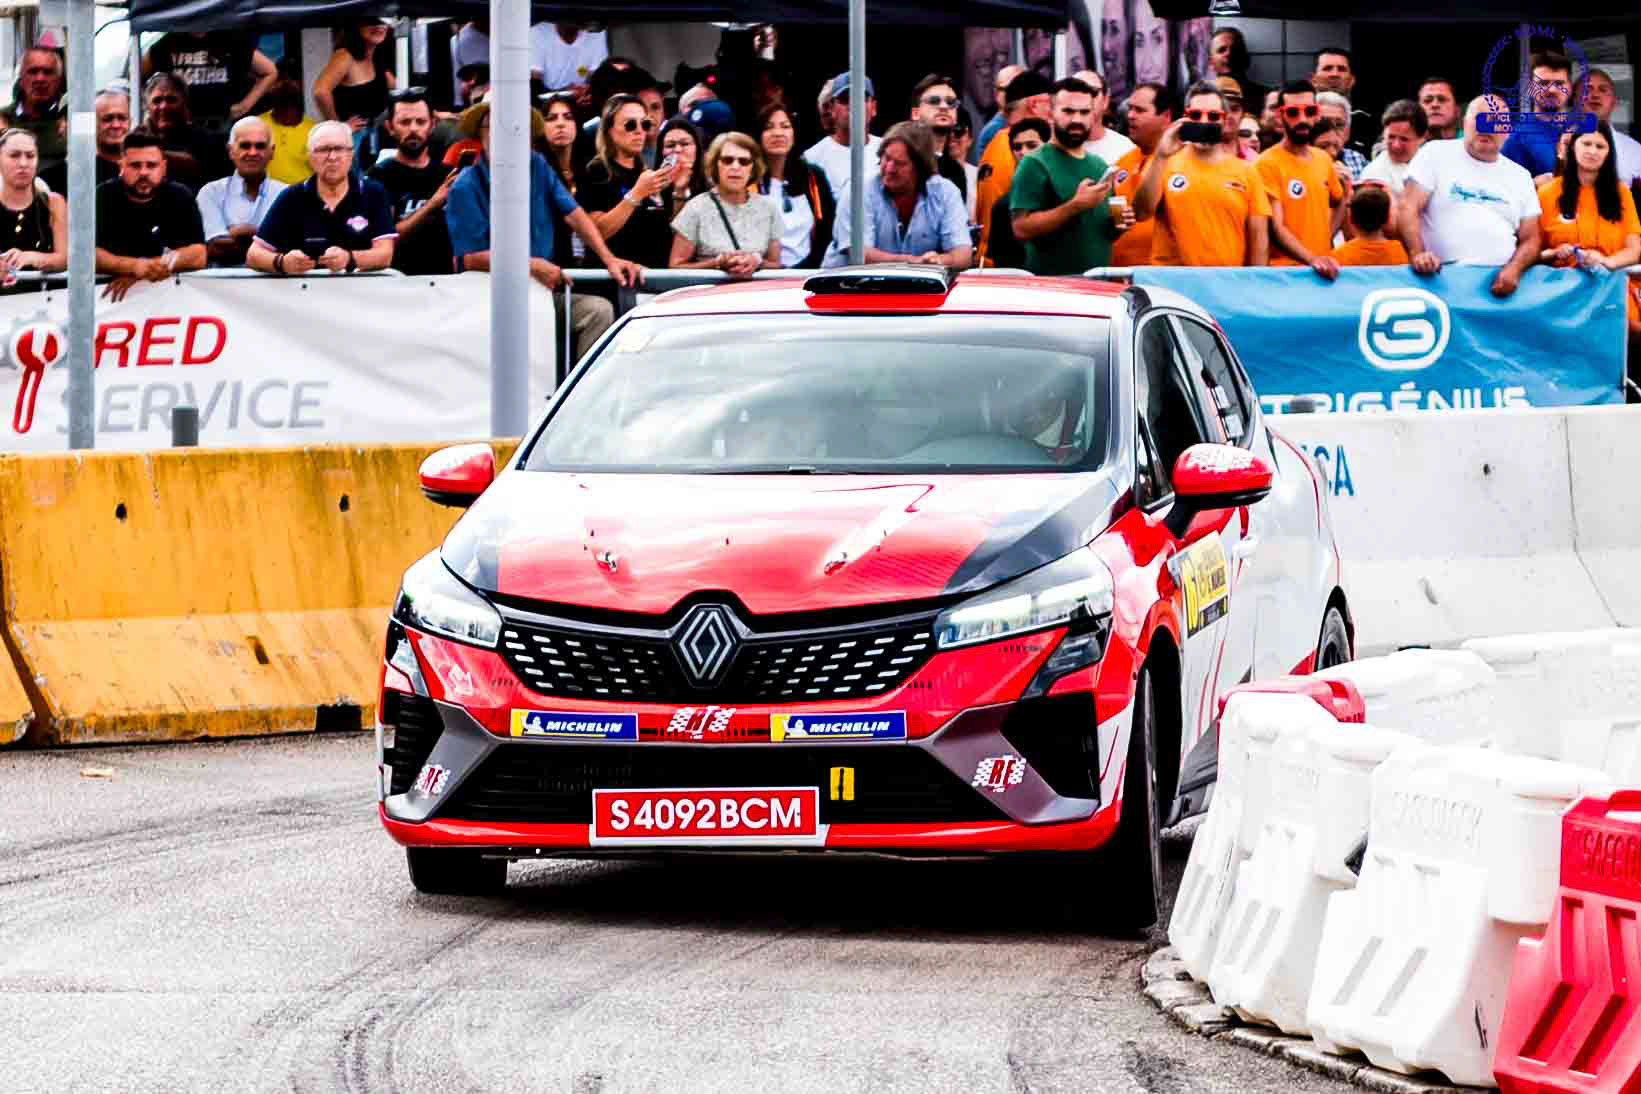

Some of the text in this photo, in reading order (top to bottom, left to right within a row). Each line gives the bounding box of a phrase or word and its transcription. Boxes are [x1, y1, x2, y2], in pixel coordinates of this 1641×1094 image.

[92, 315, 228, 369] RED
[546, 720, 623, 733] MICHELIN
[809, 721, 890, 733] MICHELIN
